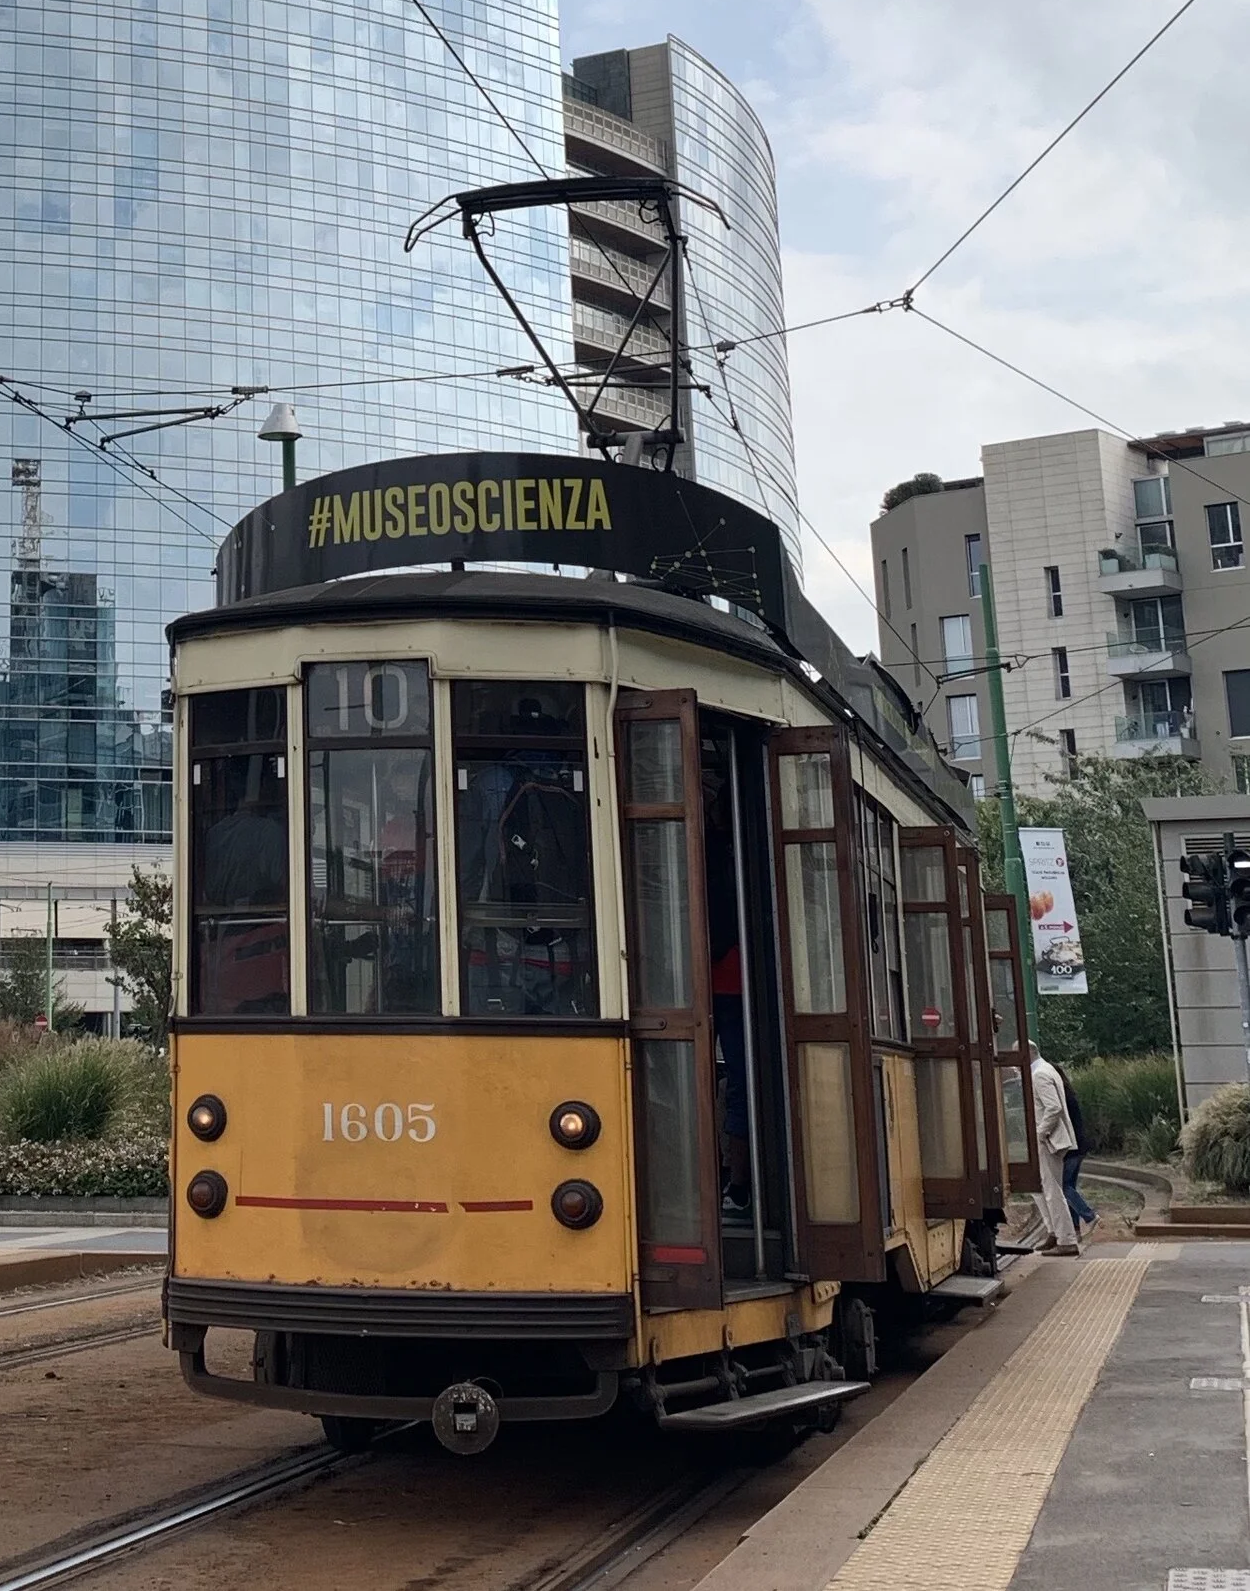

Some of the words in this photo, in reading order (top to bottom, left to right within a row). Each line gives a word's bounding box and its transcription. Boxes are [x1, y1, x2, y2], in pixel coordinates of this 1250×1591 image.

[308, 478, 613, 549] #MUSEOSCIENZA
[335, 664, 409, 730] 10
[321, 1102, 437, 1143] 1605
